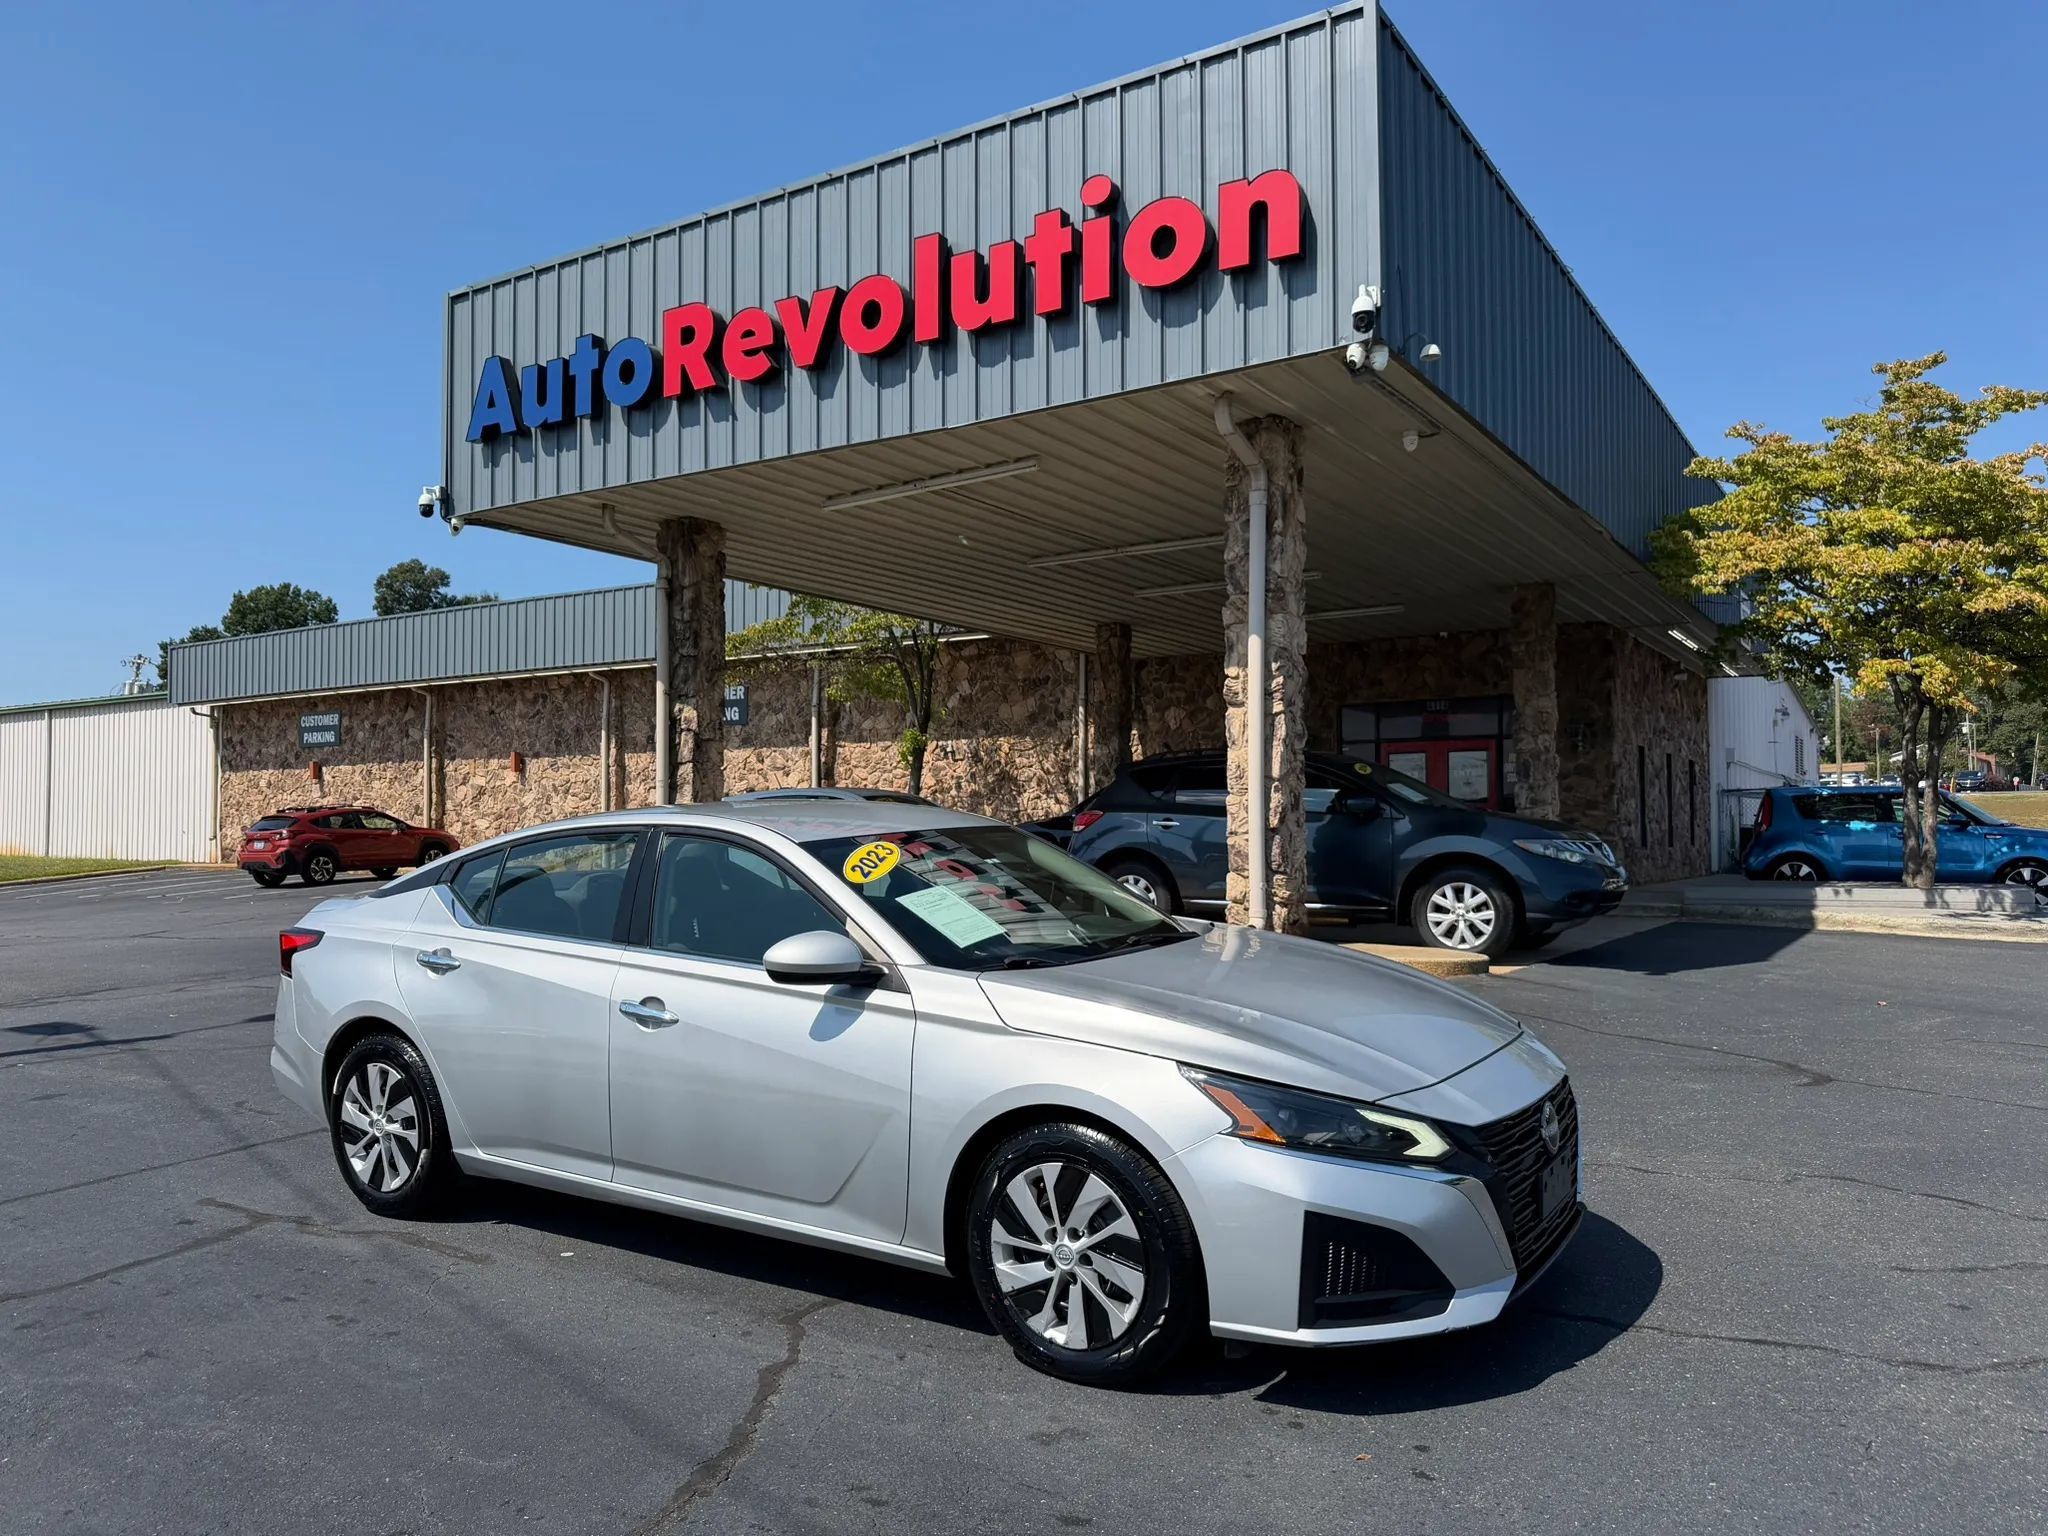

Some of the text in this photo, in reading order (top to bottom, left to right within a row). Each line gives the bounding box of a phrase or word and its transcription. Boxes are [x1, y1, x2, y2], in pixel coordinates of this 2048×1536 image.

[301, 714, 339, 727] CUSTOMER
[303, 731, 335, 744] PARKING
[850, 844, 894, 880] 2023
